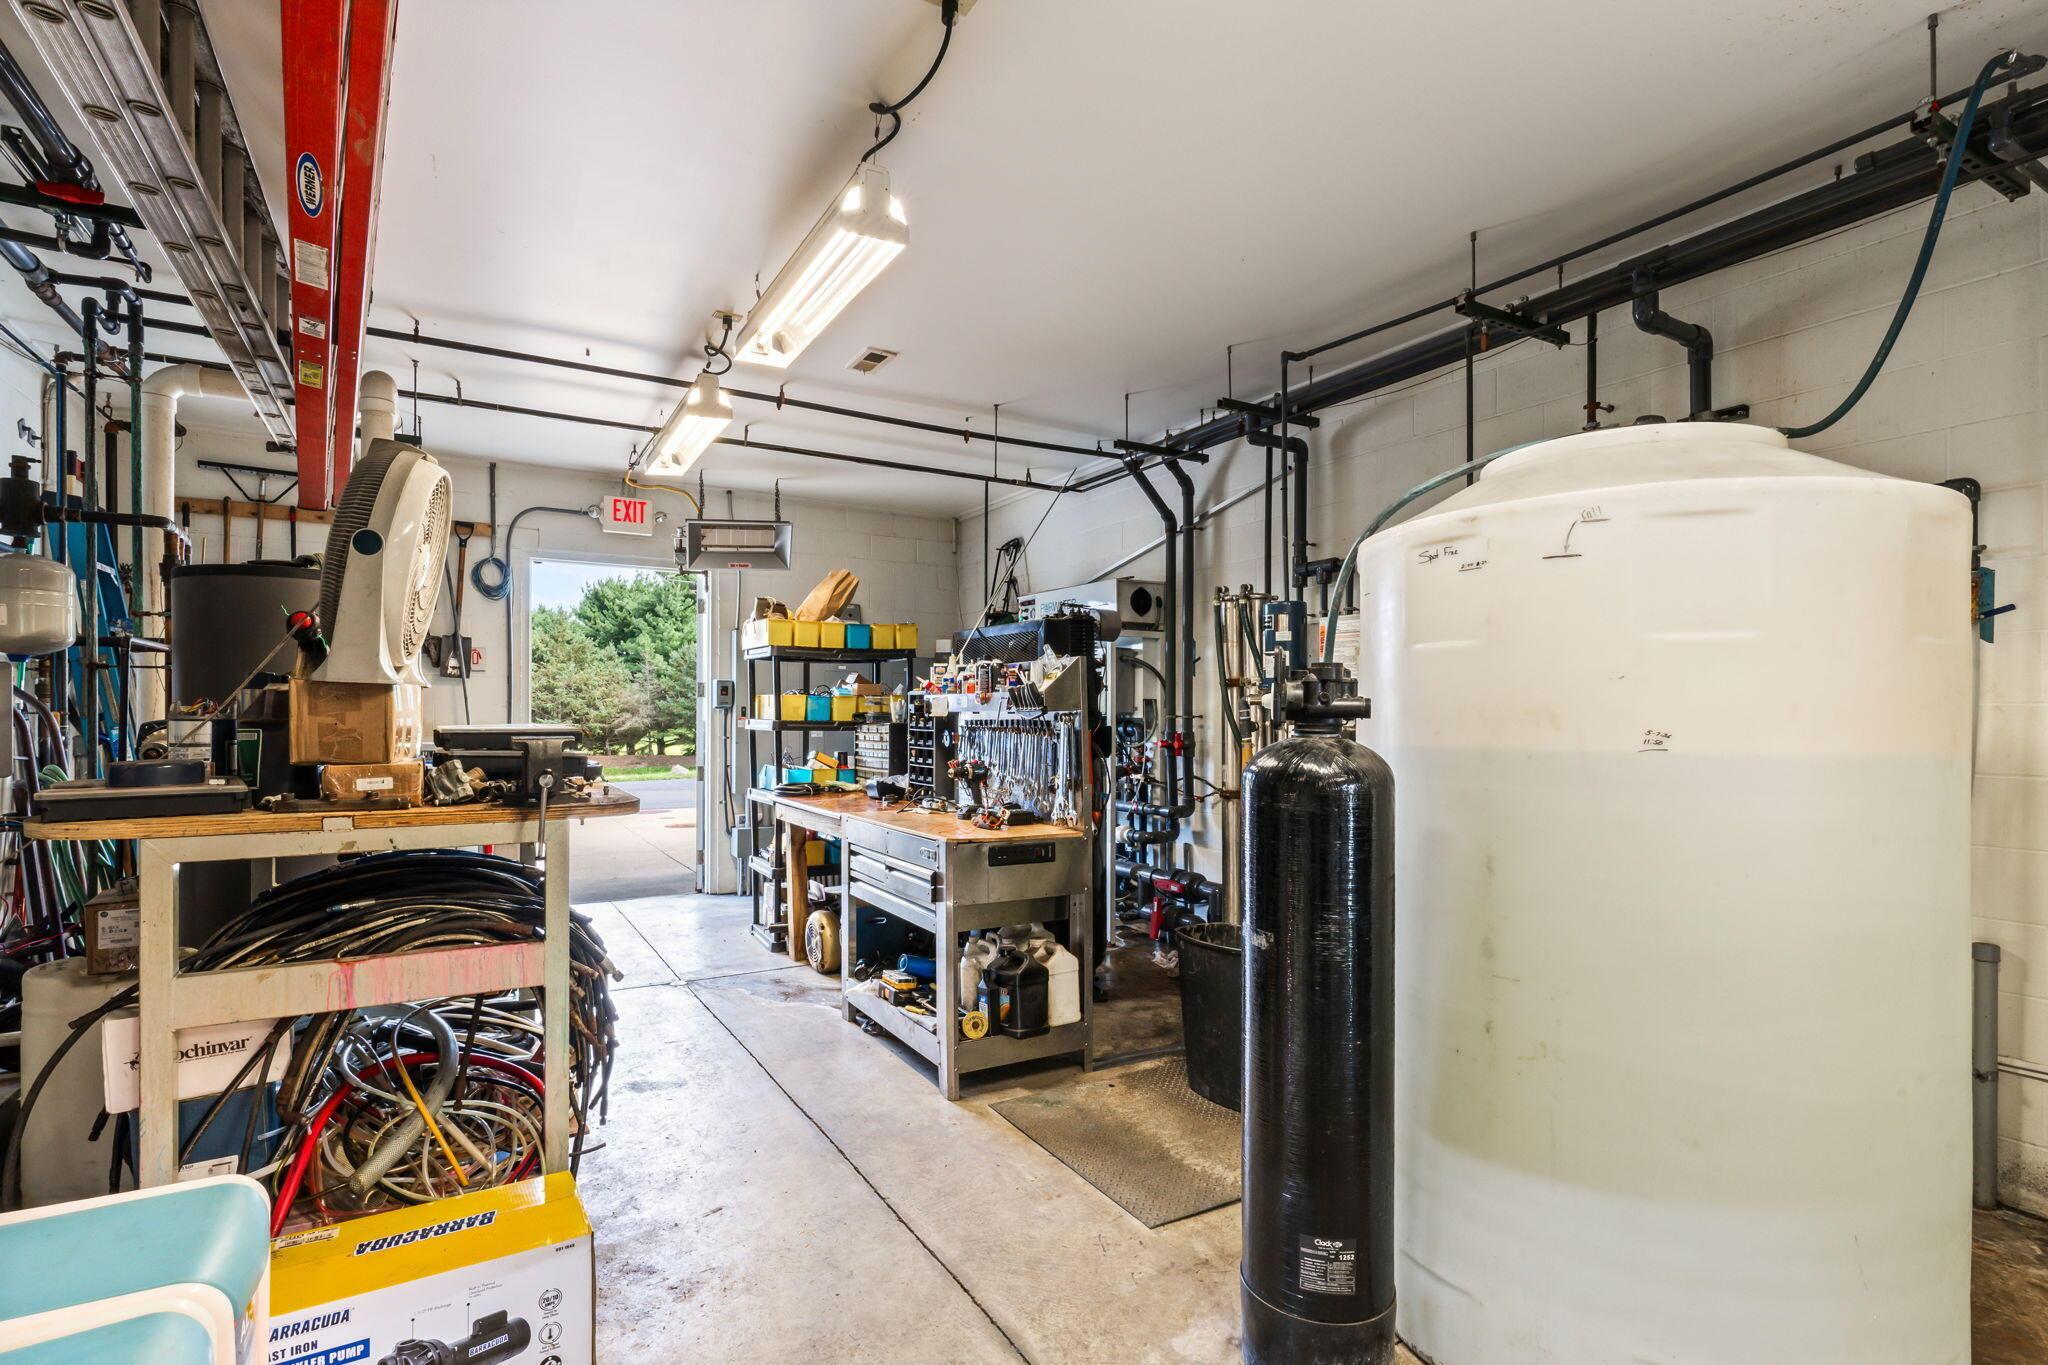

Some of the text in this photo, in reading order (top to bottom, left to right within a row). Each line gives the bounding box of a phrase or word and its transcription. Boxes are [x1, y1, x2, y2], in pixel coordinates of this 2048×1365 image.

[303, 165, 317, 206] WERNER
[612, 498, 647, 524] EXIT
[175, 1038, 250, 1061] ochinvar
[355, 1211, 496, 1256] BARRACUDA
[268, 1309, 351, 1343] ARRACUDA
[268, 1348, 286, 1362] ST
[290, 1340, 318, 1356] IRON
[329, 1344, 364, 1364] PUMP
[469, 1334, 508, 1357] BARRACUDA
